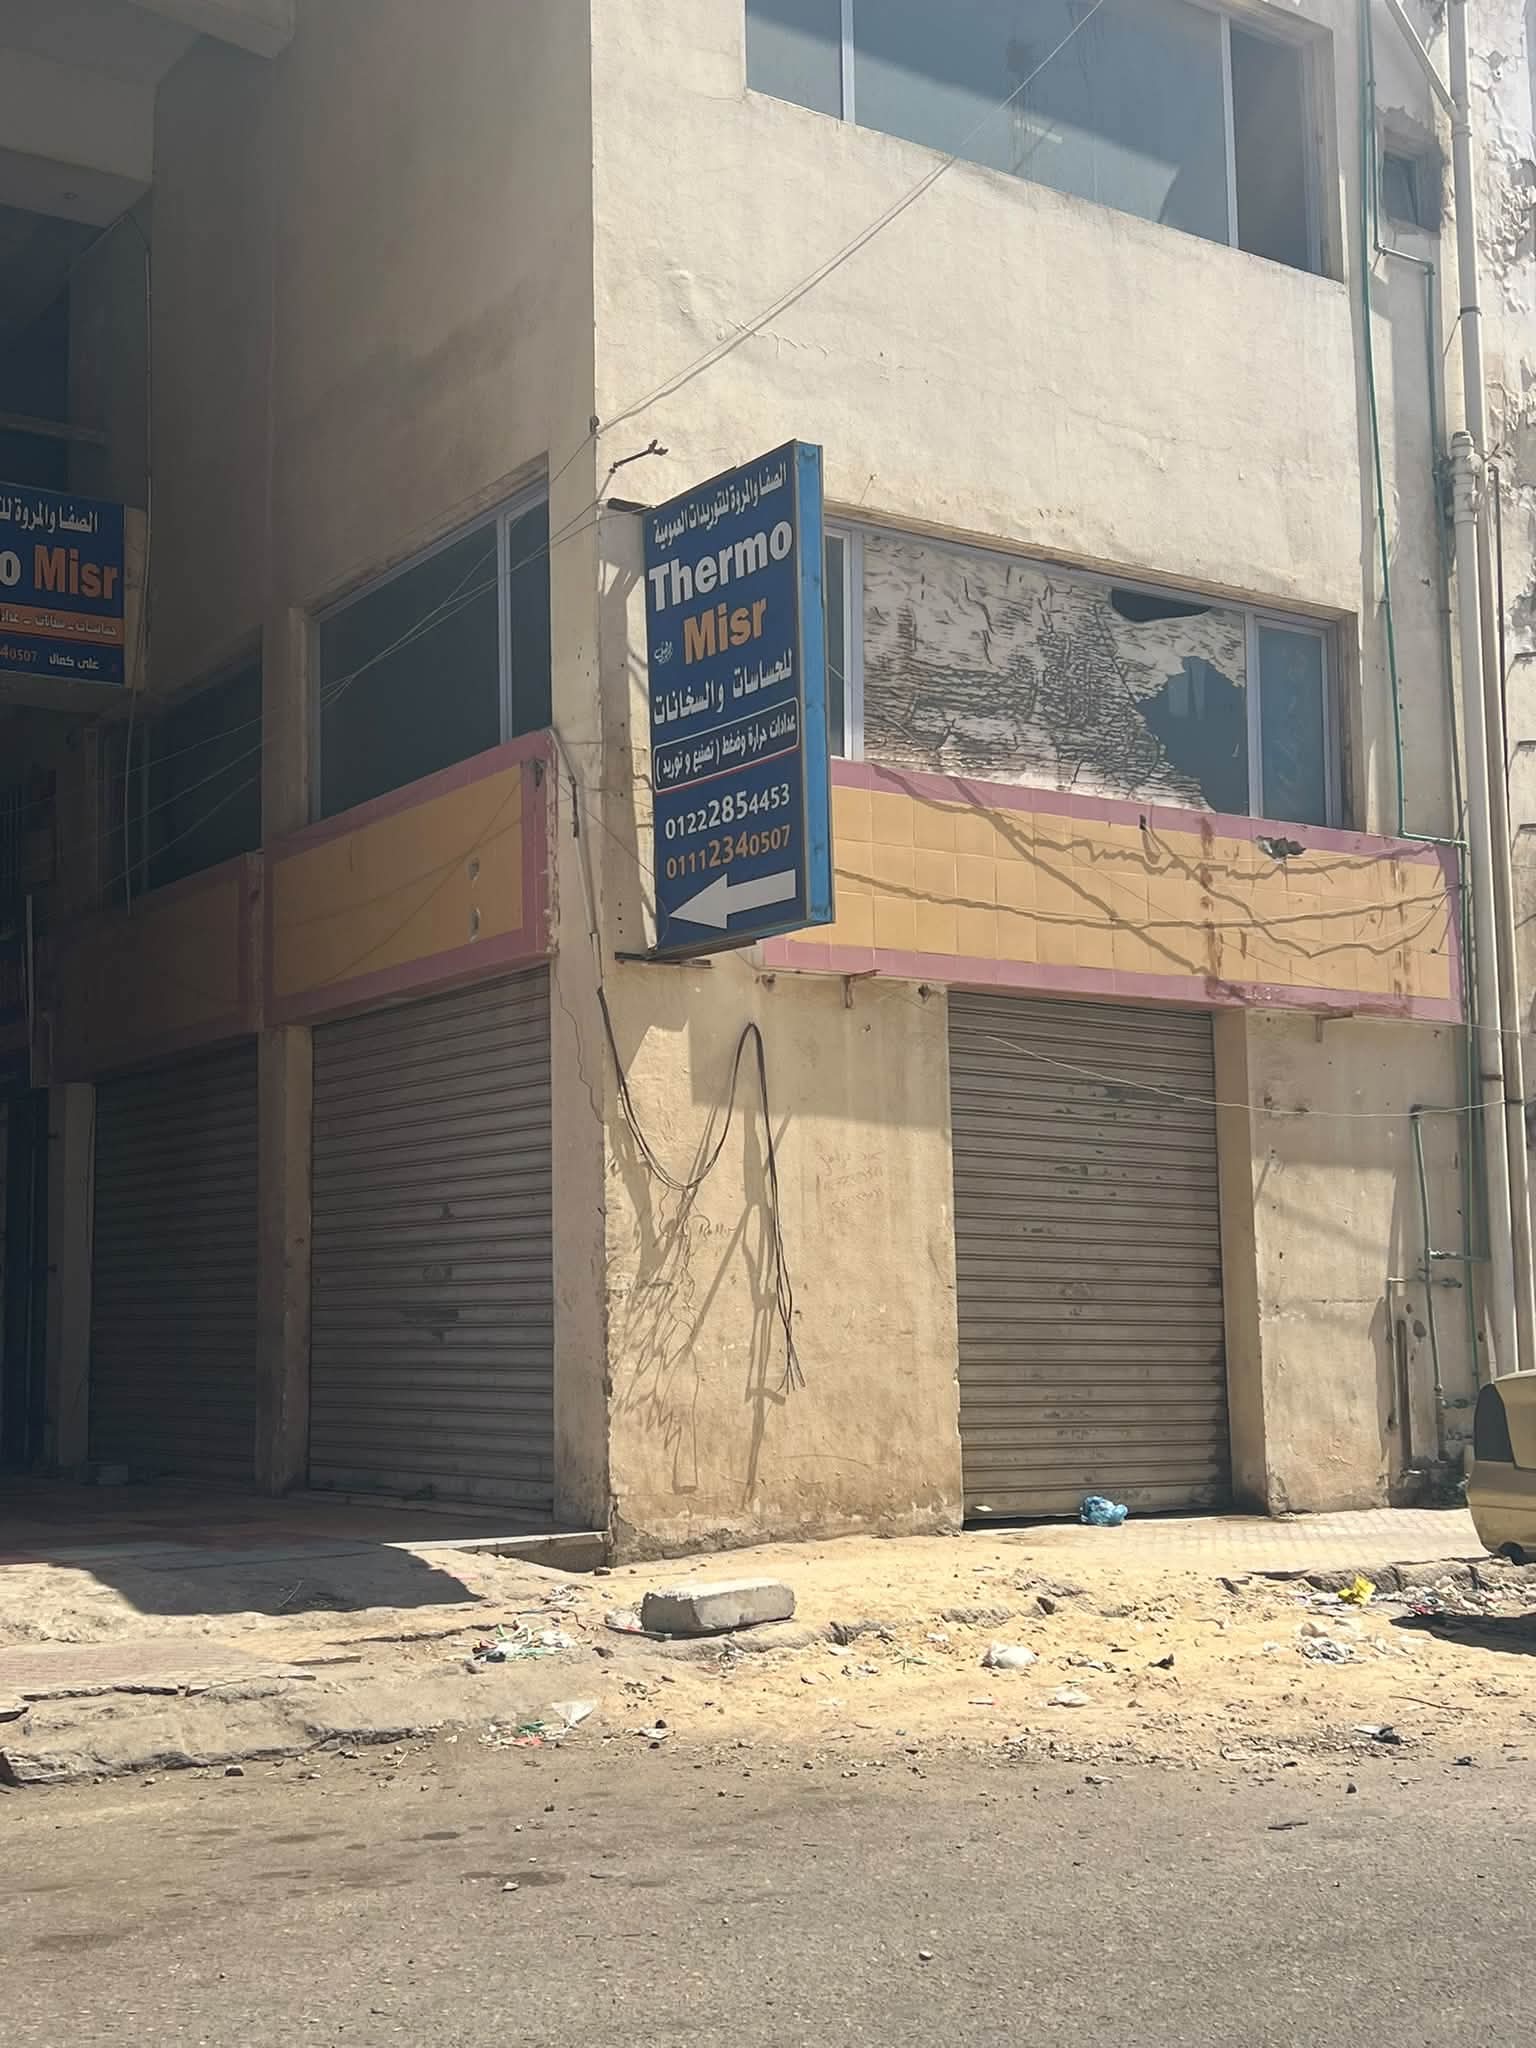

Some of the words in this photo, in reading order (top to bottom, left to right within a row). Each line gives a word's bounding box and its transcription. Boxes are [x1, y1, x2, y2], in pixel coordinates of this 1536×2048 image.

[730, 477, 760, 515] والمروة
[759, 461, 787, 497] الصفا
[14, 497, 57, 534] والمروة
[58, 505, 98, 534] الصفا
[689, 488, 731, 531] للتوريدات
[33, 544, 119, 599] Misr
[649, 521, 793, 612] Thermo
[683, 597, 767, 665] Misr
[733, 648, 792, 698] للحساسات
[722, 731, 746, 757] وضغط
[769, 713, 796, 738] عدادات
[665, 783, 790, 839] 01222854453
[666, 824, 791, 879] 01112340507
